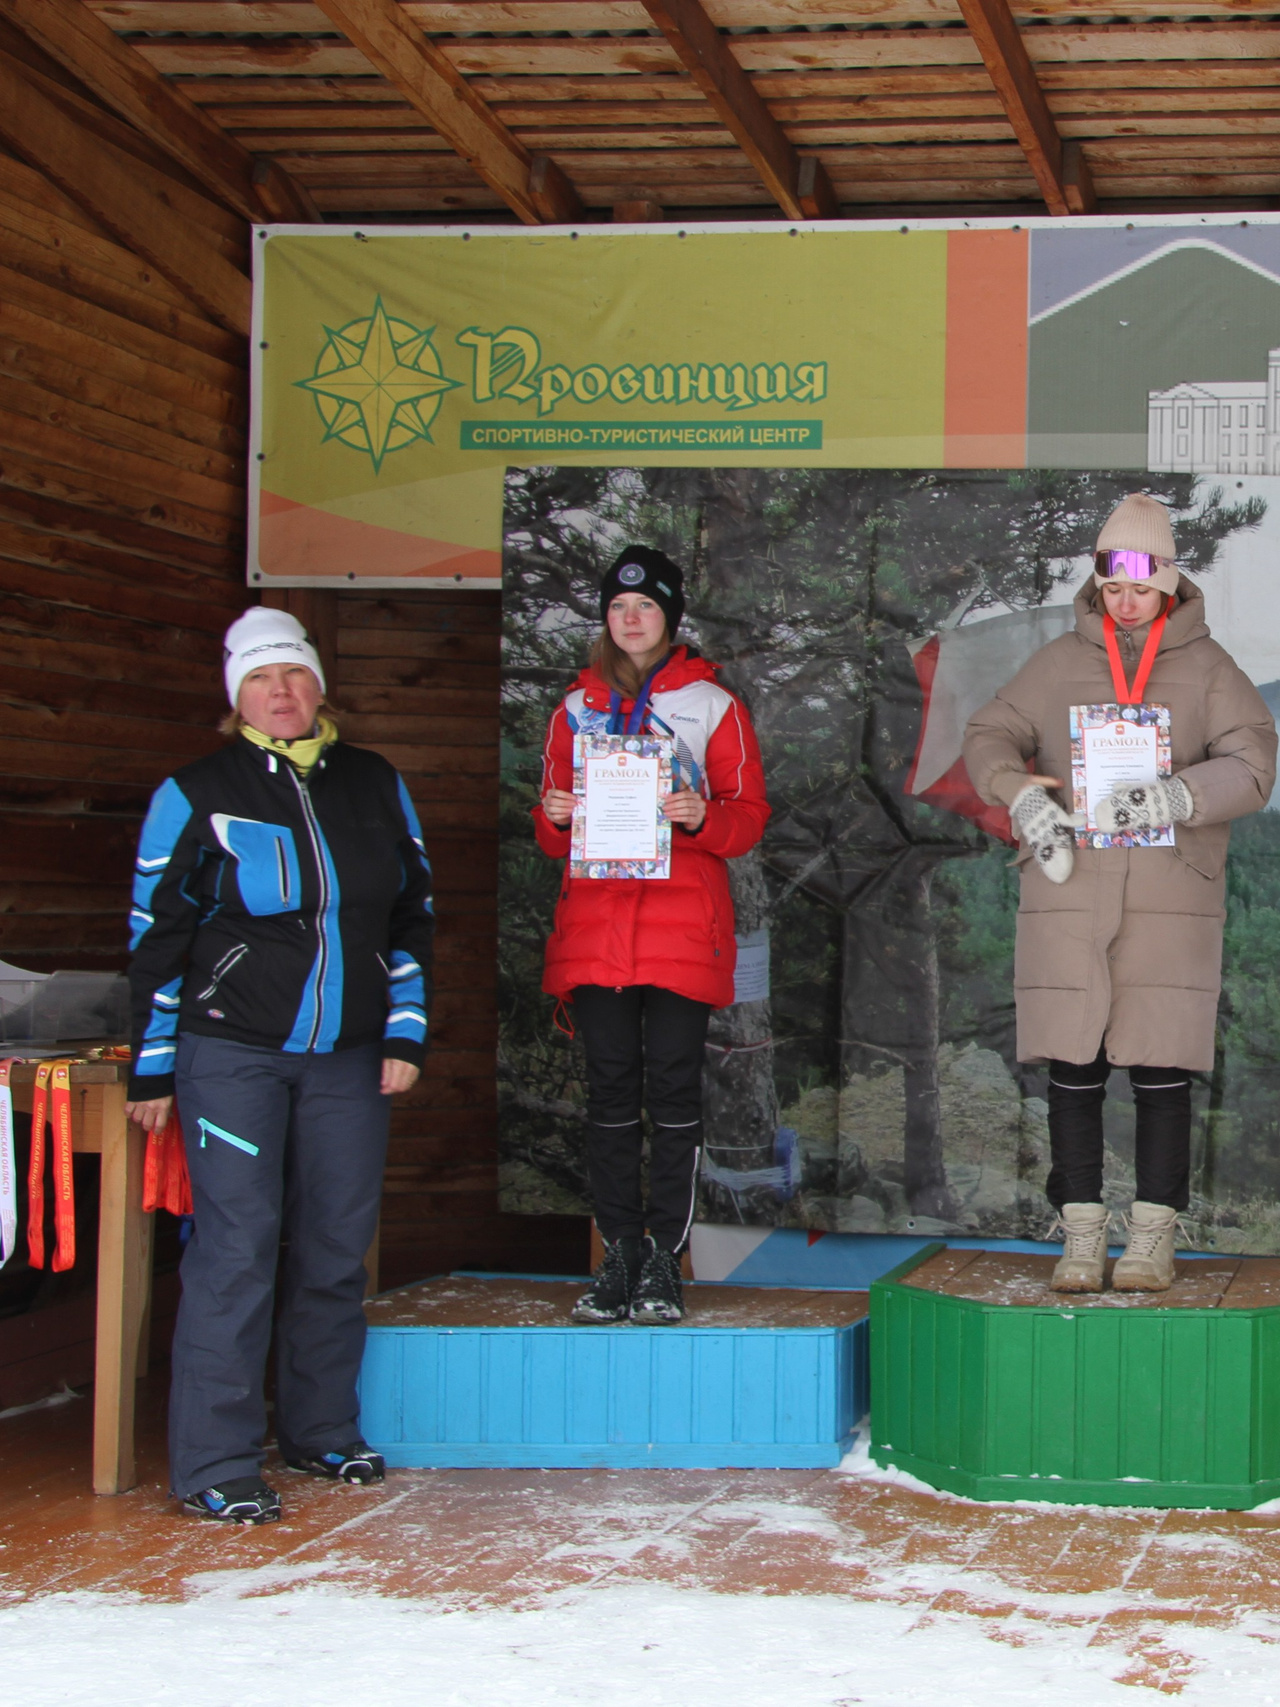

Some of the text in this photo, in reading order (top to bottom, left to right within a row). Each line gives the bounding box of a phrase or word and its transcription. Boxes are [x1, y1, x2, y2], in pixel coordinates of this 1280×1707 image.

[455, 325, 828, 418] Провинция
[472, 424, 811, 446] СПОРТИВНО-ТУРИСТИЧЕСКИЙ ЦЕНТР
[1092, 737, 1149, 748] ГРАМОТА
[594, 768, 650, 779] ГРАМОТА
[60, 1103, 71, 1201] ЧЕЛЯБИНСКАЯ ОБЛАСТЬ
